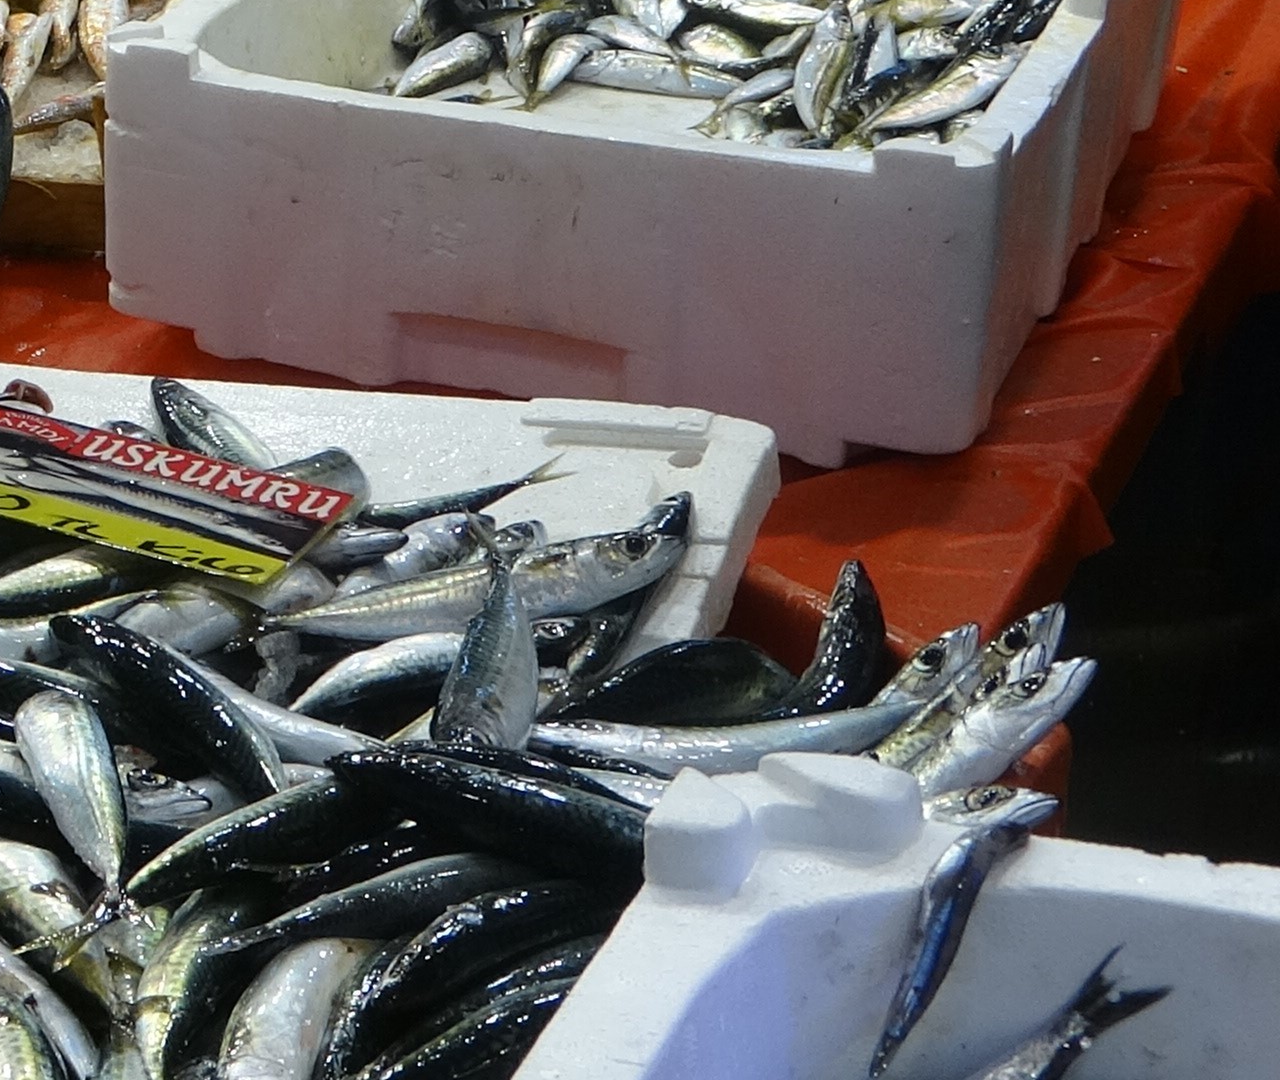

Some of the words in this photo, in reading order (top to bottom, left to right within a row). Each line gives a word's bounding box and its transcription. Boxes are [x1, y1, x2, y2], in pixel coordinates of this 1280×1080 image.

[82, 433, 342, 519] USKUMRU
[49, 515, 116, 540] TL
[138, 538, 266, 577] KİLO
